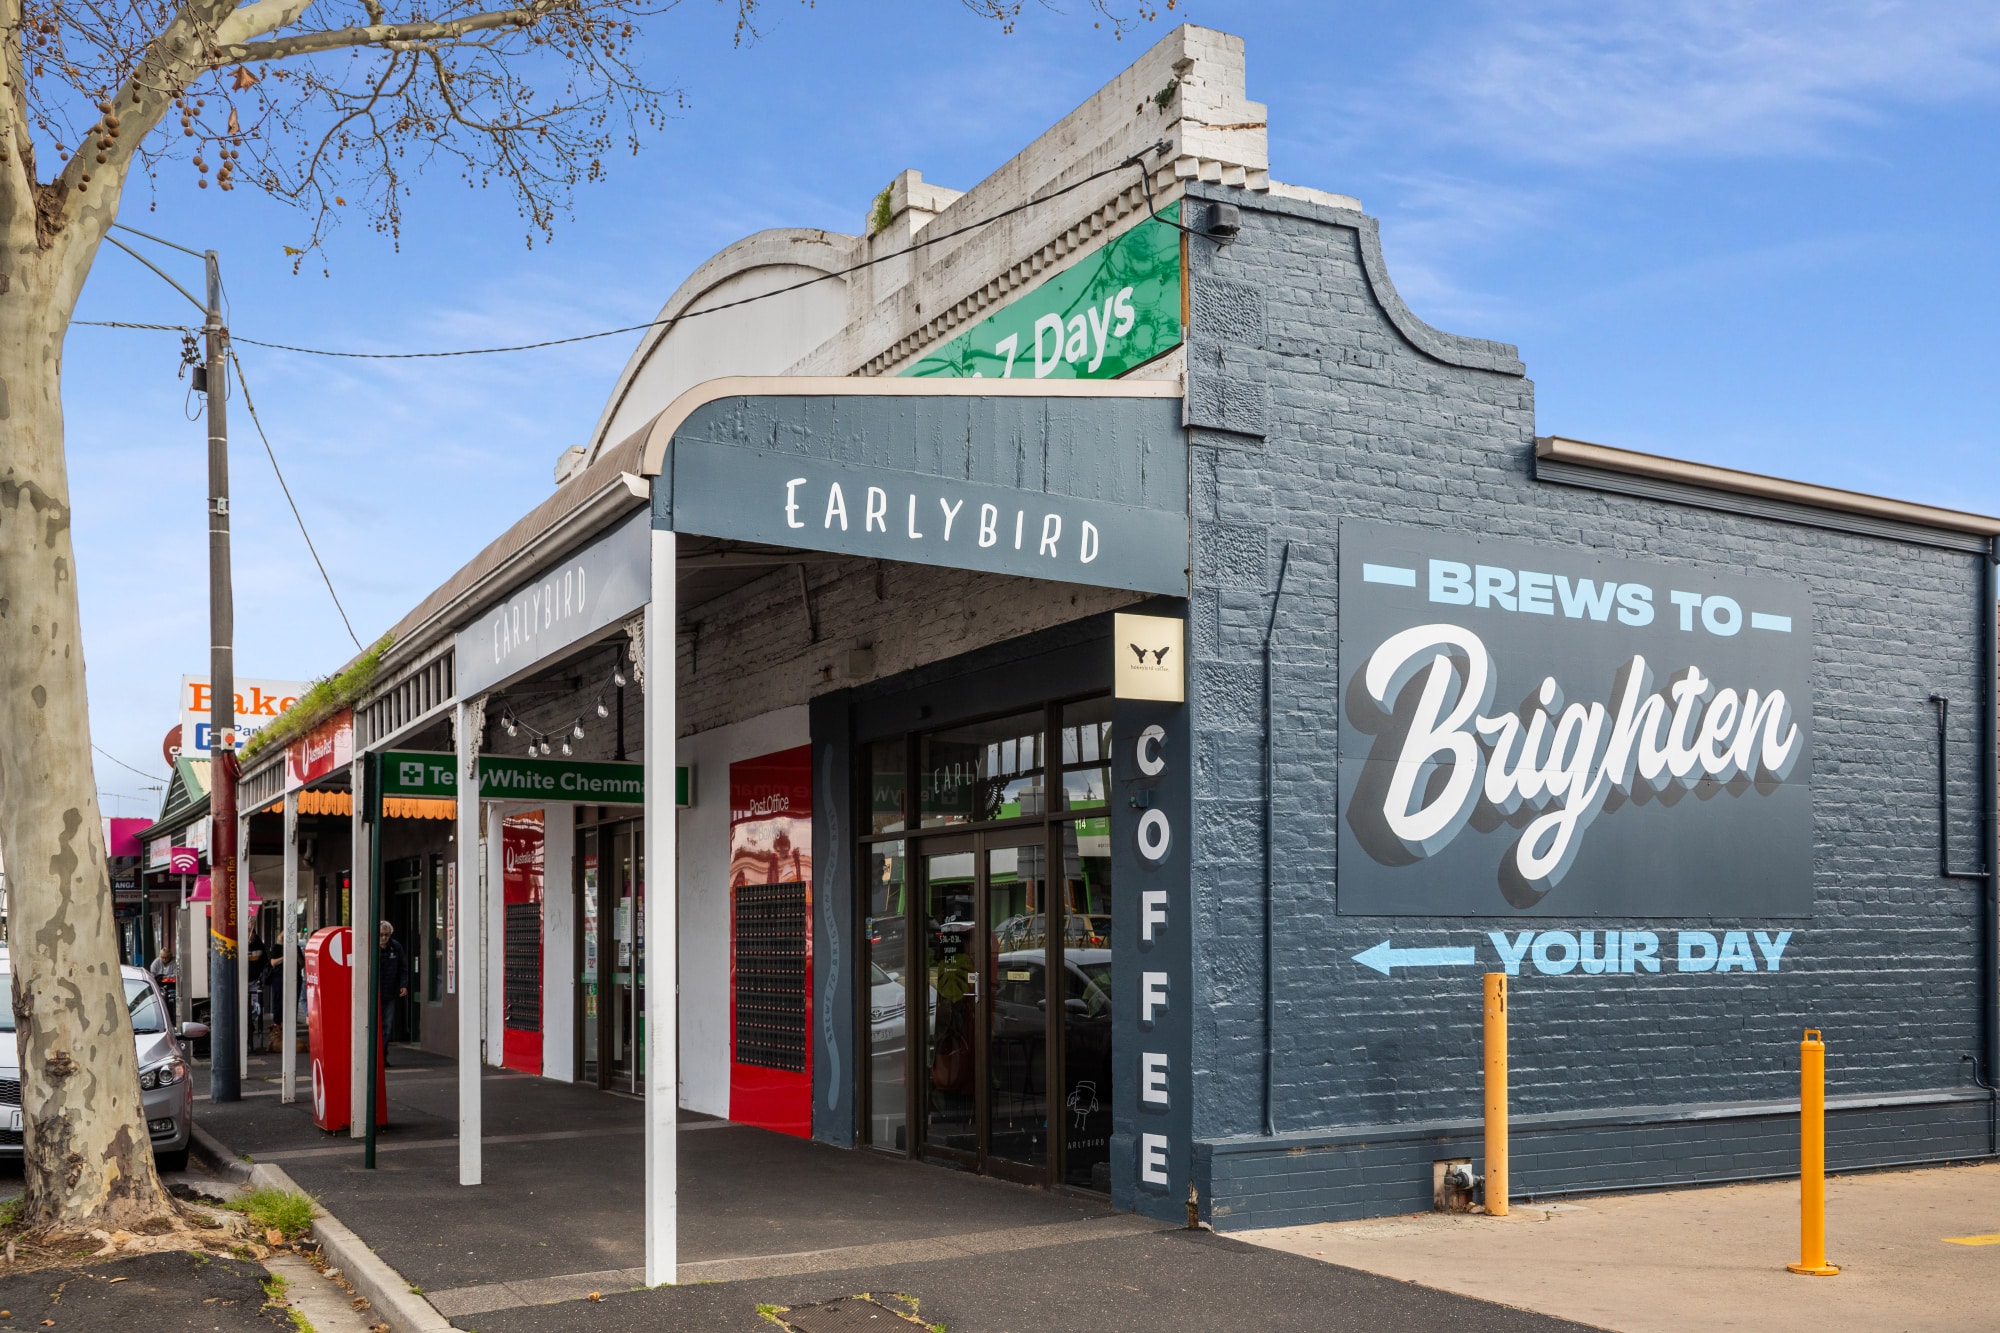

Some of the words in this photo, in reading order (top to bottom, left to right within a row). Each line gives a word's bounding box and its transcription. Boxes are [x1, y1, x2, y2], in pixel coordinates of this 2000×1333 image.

[996, 332, 1018, 378] 7
[1035, 287, 1135, 378] Days
[785, 478, 1099, 564] EARLYBIRD
[494, 566, 586, 665] EARLYBIRD
[1428, 558, 1655, 627] BREWS
[1670, 590, 1743, 637] TO
[429, 766, 555, 790] TeyWhite
[934, 751, 1029, 794] EARLYI
[1365, 623, 1797, 881] Brighten
[750, 797, 766, 813] Post
[767, 793, 789, 813] Office
[227, 856, 236, 872] flat
[228, 876, 236, 926] kangaroo
[1136, 724, 1170, 1186] COFFEE
